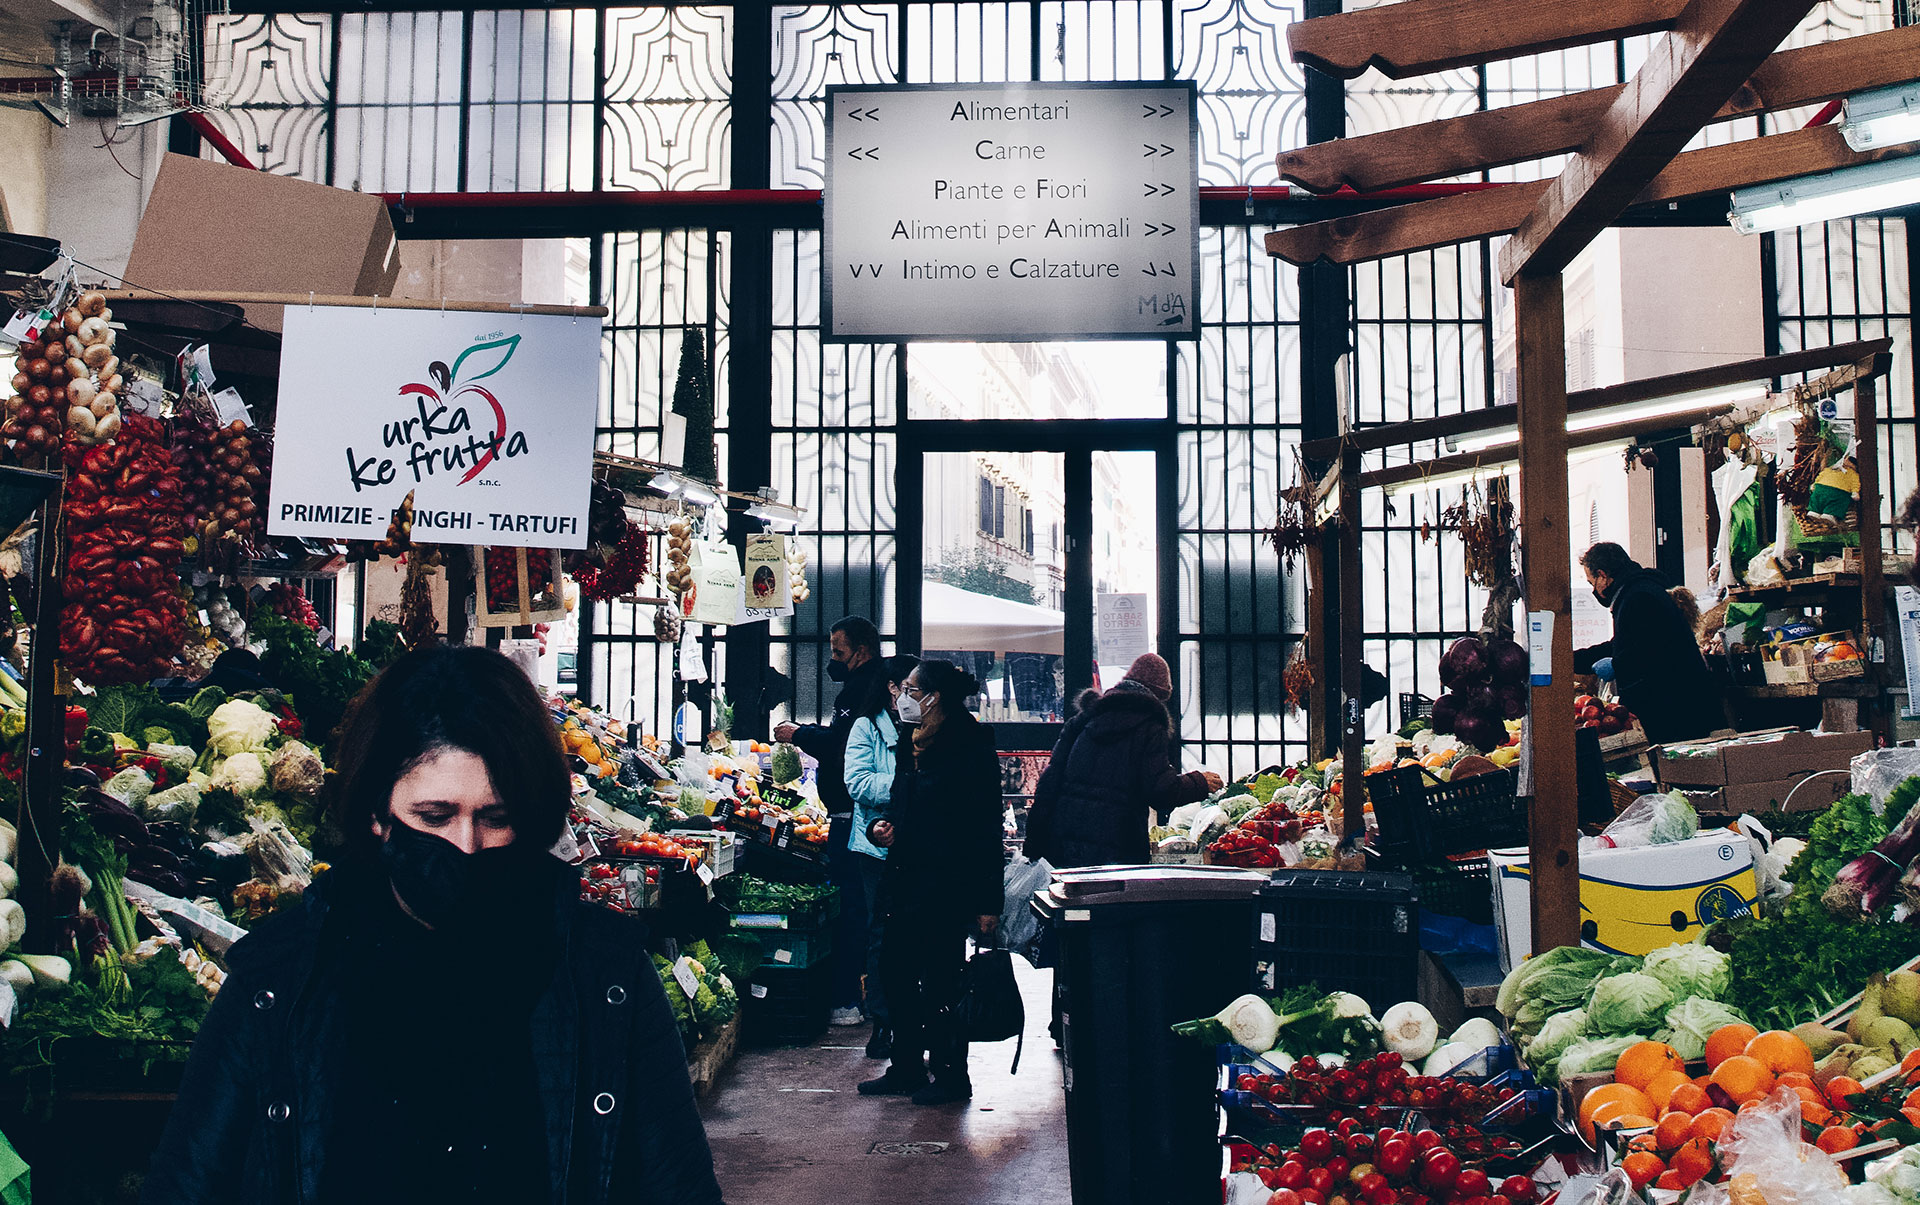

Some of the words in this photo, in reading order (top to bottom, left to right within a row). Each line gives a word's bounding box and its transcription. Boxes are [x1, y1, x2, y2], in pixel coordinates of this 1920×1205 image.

[950, 100, 1069, 121] Alimentari
[975, 139, 1046, 160] Carne
[934, 179, 1003, 200] Piante
[1013, 184, 1026, 199] e
[1036, 178, 1087, 199] Fiori
[891, 219, 987, 240] Alimenti
[997, 221, 1036, 245] per
[1044, 217, 1130, 238] Animali
[903, 258, 976, 280] Intimo
[986, 264, 999, 279] e
[1009, 257, 1119, 279] Calzature
[383, 396, 471, 449] urka
[346, 447, 396, 492] ke
[406, 431, 529, 482] frutta
[280, 503, 373, 525] PRIMIZIE
[391, 507, 472, 530] NGHI
[489, 513, 577, 535] TARTUFI
